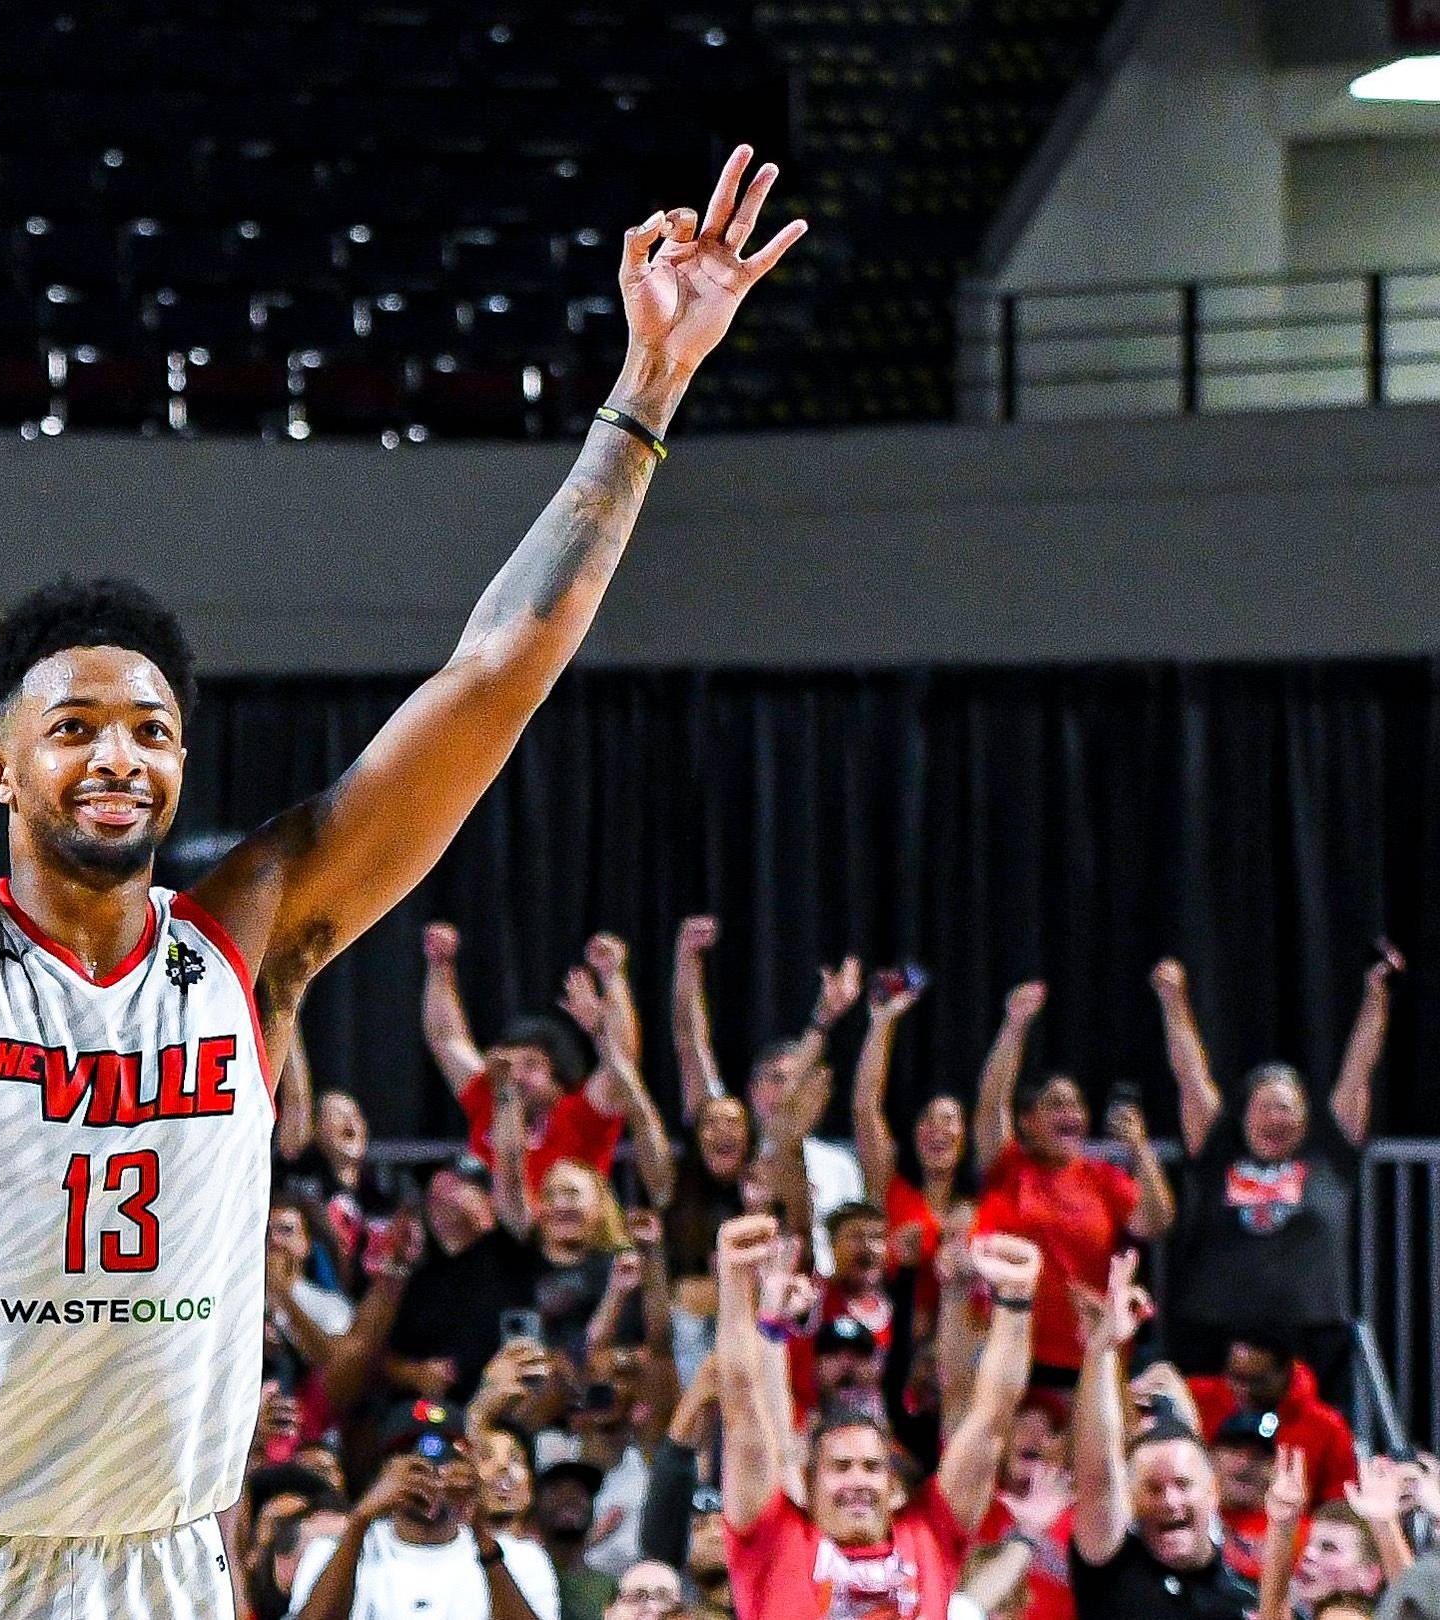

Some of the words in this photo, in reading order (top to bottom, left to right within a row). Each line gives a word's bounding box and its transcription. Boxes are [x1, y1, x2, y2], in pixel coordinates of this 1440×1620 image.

[41, 1035, 237, 1128] VILLE
[62, 1149, 160, 1274] 13
[1, 1297, 216, 1324] WASTEOLOG
